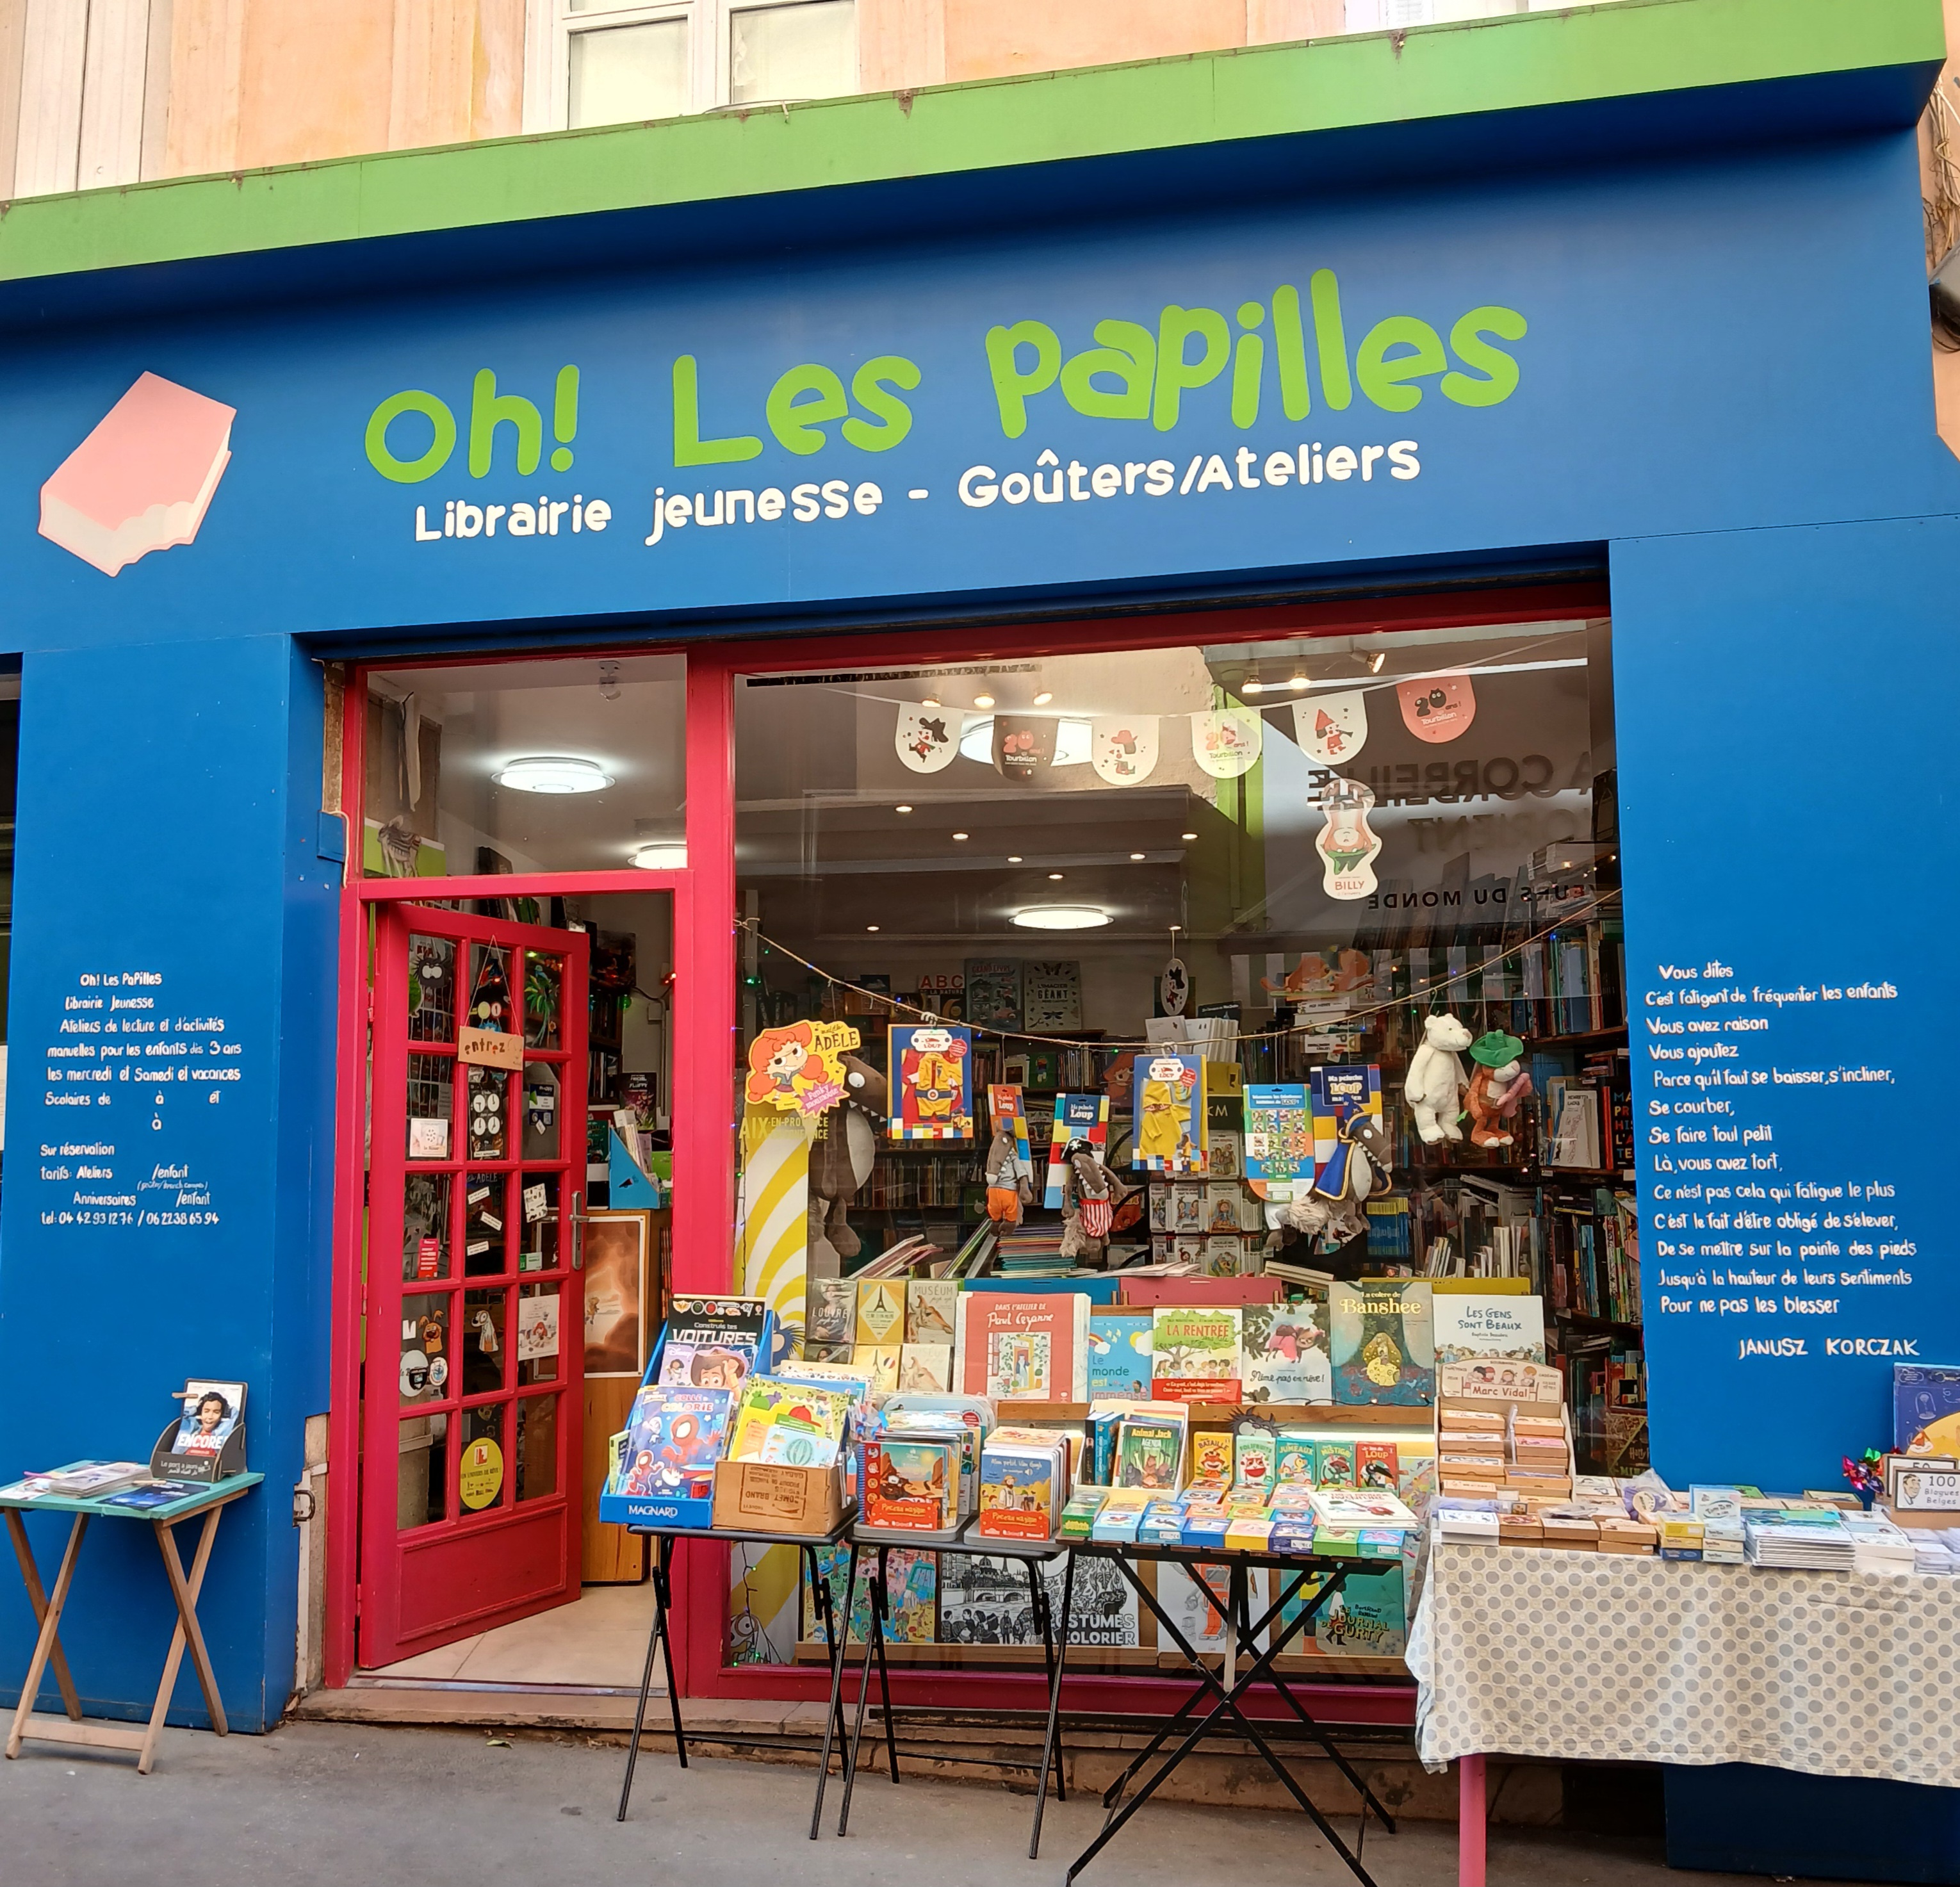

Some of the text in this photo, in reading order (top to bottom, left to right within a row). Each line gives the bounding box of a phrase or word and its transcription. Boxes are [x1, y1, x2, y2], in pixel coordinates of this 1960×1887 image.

[672, 352, 922, 468] Les
[414, 493, 613, 543] Librairie
[644, 478, 884, 547] jeunesse
[1335, 881, 1365, 890] BILLY
[1658, 960, 1734, 980] Vous dites
[79, 974, 101, 986] Oh!
[103, 974, 120, 986] Les
[1645, 981, 1898, 1009] C'est fatigant de fréquenter les enfants
[60, 1017, 225, 1033] Ateliers de lecture et d'activités
[1646, 1016, 1768, 1034] Vous avez raison
[47, 1043, 95, 1058] manuelles
[100, 1045, 124, 1061] pour
[126, 1043, 141, 1056] les
[145, 1041, 188, 1056] enfants
[209, 1040, 221, 1055] 3
[222, 1043, 242, 1055] ans
[464, 1038, 505, 1055] entrez
[1649, 1042, 1739, 1066] Vous ajoutez
[47, 1066, 63, 1081] les
[67, 1065, 112, 1081] mercredi
[119, 1065, 130, 1081] et
[177, 1065, 188, 1082] et
[191, 1068, 241, 1081] vacances
[1654, 1070, 1692, 1088] Parce
[1722, 1068, 1749, 1085] faut
[45, 1090, 221, 1106] Scolaires de à et
[1674, 1097, 1735, 1116] courber,
[151, 1112, 162, 1131] à
[1070, 1109, 1093, 1120] Loup
[1675, 1125, 1708, 1143] faire
[1711, 1125, 1738, 1142] tout
[1743, 1124, 1772, 1147] petit
[59, 1141, 115, 1156] réservation
[1715, 1157, 1748, 1170] avez
[1750, 1152, 1783, 1172] tort,
[76, 1165, 113, 1179] Ateliers
[73, 1191, 136, 1206] Anniversaires
[1653, 1180, 1895, 1205] Ce n'est pas cela qui fatigue le plus
[1654, 1213, 1688, 1230] C'est
[1693, 1212, 1706, 1229] le
[1705, 1212, 1731, 1230] fait
[1733, 1210, 1772, 1229] d'être
[1776, 1211, 1818, 1233] obligé
[1823, 1211, 1842, 1229] de
[1657, 1240, 1676, 1257] De
[1700, 1241, 1744, 1257] mettre
[1776, 1240, 1792, 1256] la
[1799, 1240, 1840, 1261] pointe
[1848, 1240, 1874, 1256] des
[1879, 1239, 1917, 1260] pieds
[1658, 1268, 1707, 1291] Jusqu'à
[1712, 1270, 1725, 1286] la
[1727, 1268, 1777, 1286] hauteur
[1780, 1268, 1798, 1286] de
[1803, 1268, 1836, 1286] leurs
[1339, 1298, 1422, 1314] Banshee
[1660, 1295, 1840, 1316] Pour ne pas les blesser
[673, 1328, 757, 1346] VOITURES
[1166, 1324, 1180, 1336] LA
[1738, 1337, 1920, 1360] JANUSZ KORCZAK
[1092, 1355, 1104, 1365] Le
[1092, 1366, 1130, 1376] monde
[1473, 1385, 1528, 1398] Marc Vidal
[1131, 1428, 1172, 1439] Animal Jack
[1365, 1451, 1389, 1459] LOUP
[1929, 1476, 1957, 1487] 100
[1924, 1488, 1960, 1497] Blagues
[1926, 1497, 1957, 1506] Belges
[628, 1504, 678, 1519] MAGNARD
